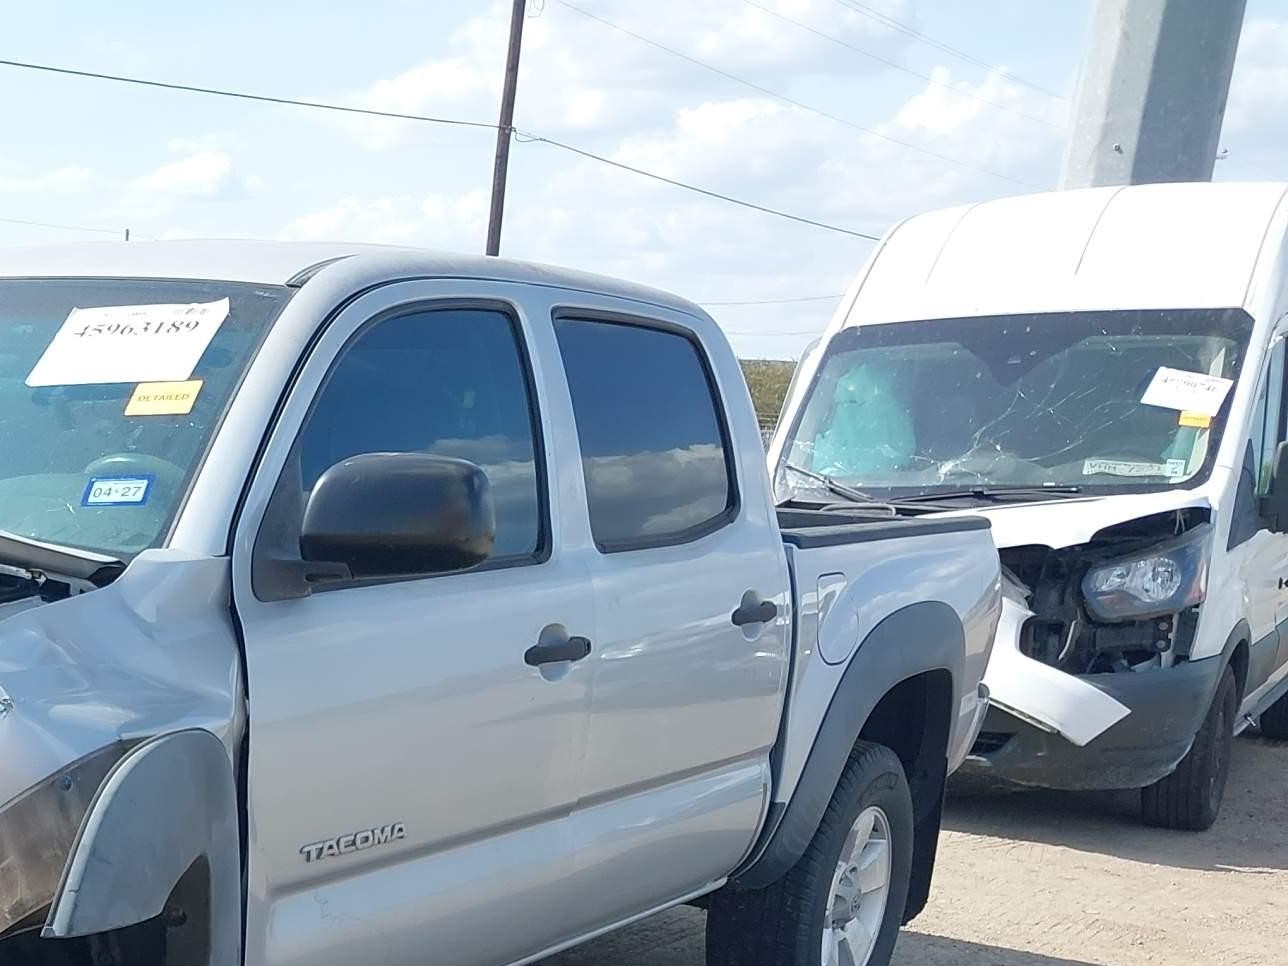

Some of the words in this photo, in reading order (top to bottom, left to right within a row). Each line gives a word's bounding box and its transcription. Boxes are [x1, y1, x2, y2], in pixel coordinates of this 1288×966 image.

[73, 320, 200, 338] 45963189
[137, 393, 191, 402] DETAILED
[299, 822, 407, 862] TACOMA
